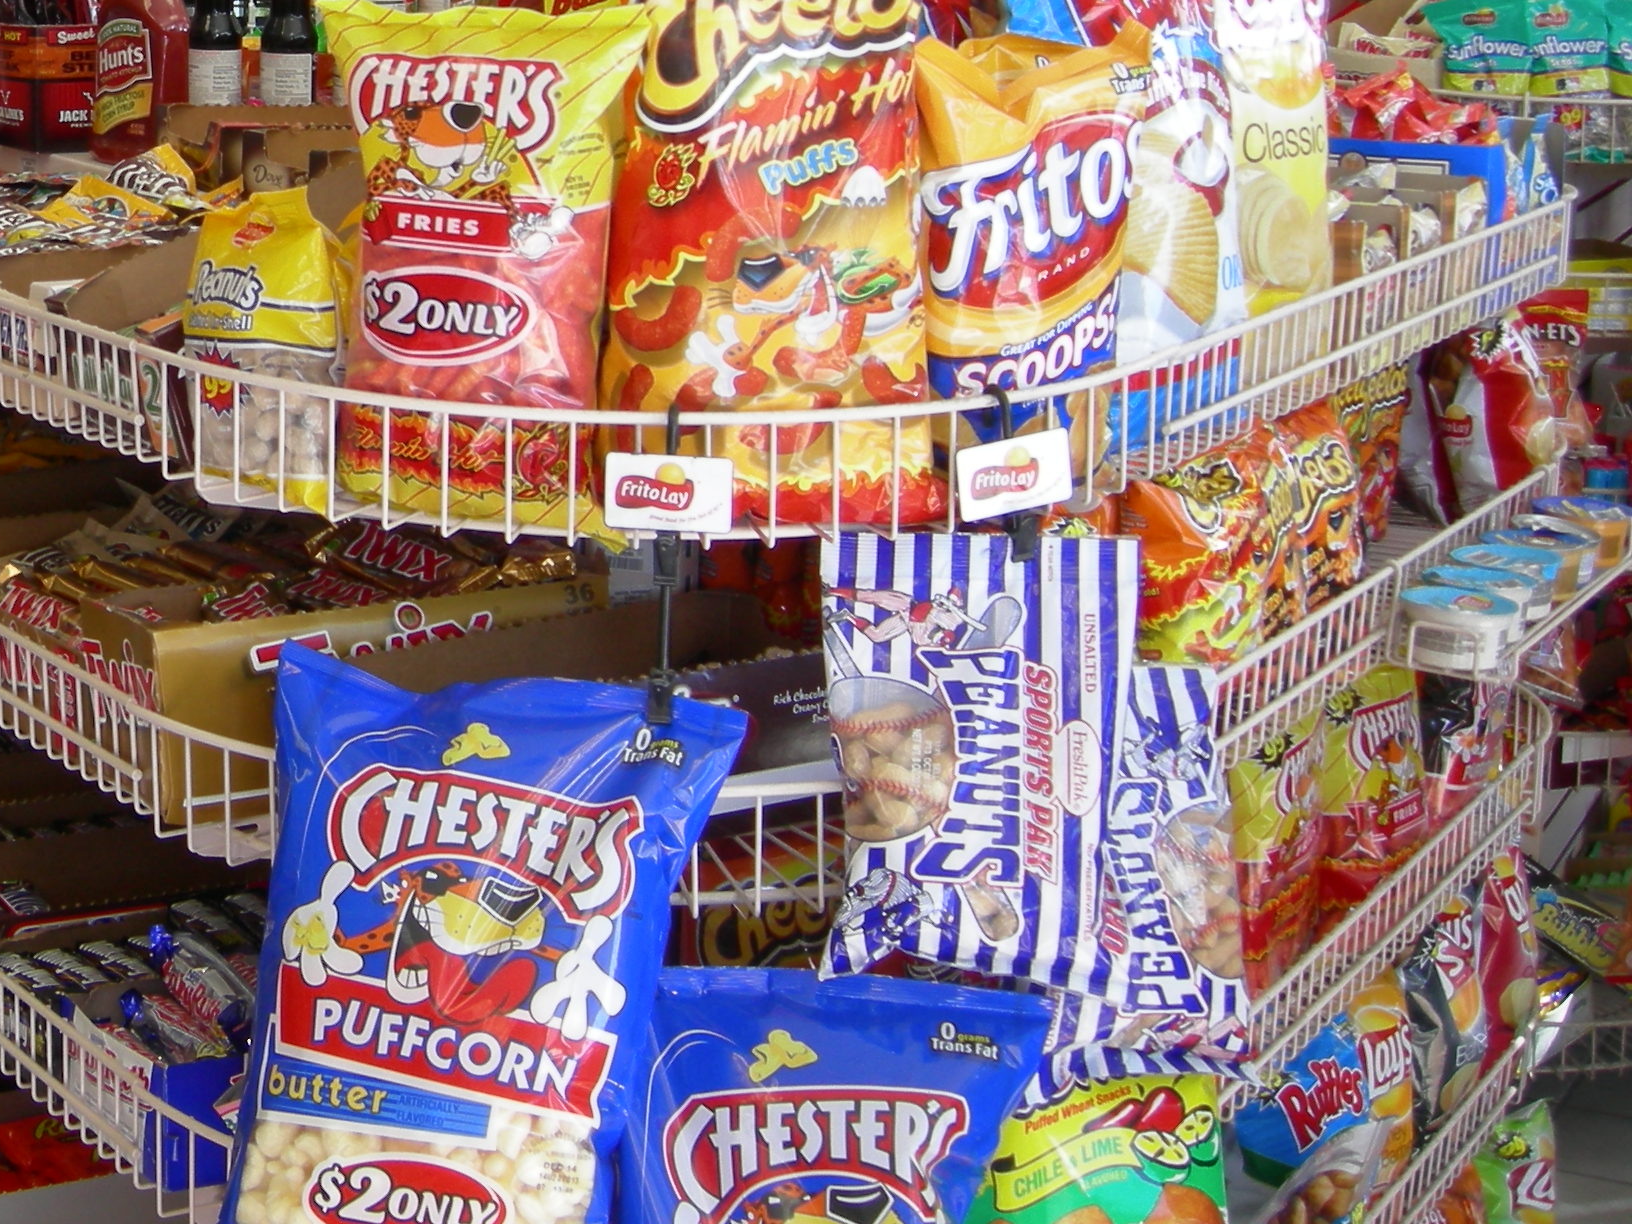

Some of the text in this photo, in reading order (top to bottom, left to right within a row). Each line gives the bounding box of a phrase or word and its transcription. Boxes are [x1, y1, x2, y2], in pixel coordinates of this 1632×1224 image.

[4, 33, 21, 41] HOT
[57, 29, 95, 45] Sweet
[99, 47, 145, 74] Hunt's
[1447, 36, 1530, 61] Sunflower
[59, 110, 87, 122] JACK
[352, 59, 557, 152] CHESTER'S
[1242, 116, 1326, 164] Classic
[758, 137, 859, 194] Puffs
[397, 213, 480, 237] FRIES
[564, 584, 595, 604] 36
[1083, 613, 1097, 693] UNSALTED
[659, 748, 684, 766] Fat
[915, 650, 1020, 884] PEANUTS
[341, 770, 632, 912] CHESTER'S
[314, 996, 577, 1095] PUFFCORN
[930, 1038, 999, 1060] Trans Fat
[268, 1069, 387, 1115] butter
[1024, 1085, 1132, 1135] Puffed Wheat Snacks
[674, 1101, 960, 1223] CHESTER'S
[1013, 1136, 1123, 1199] CHILE LIME
